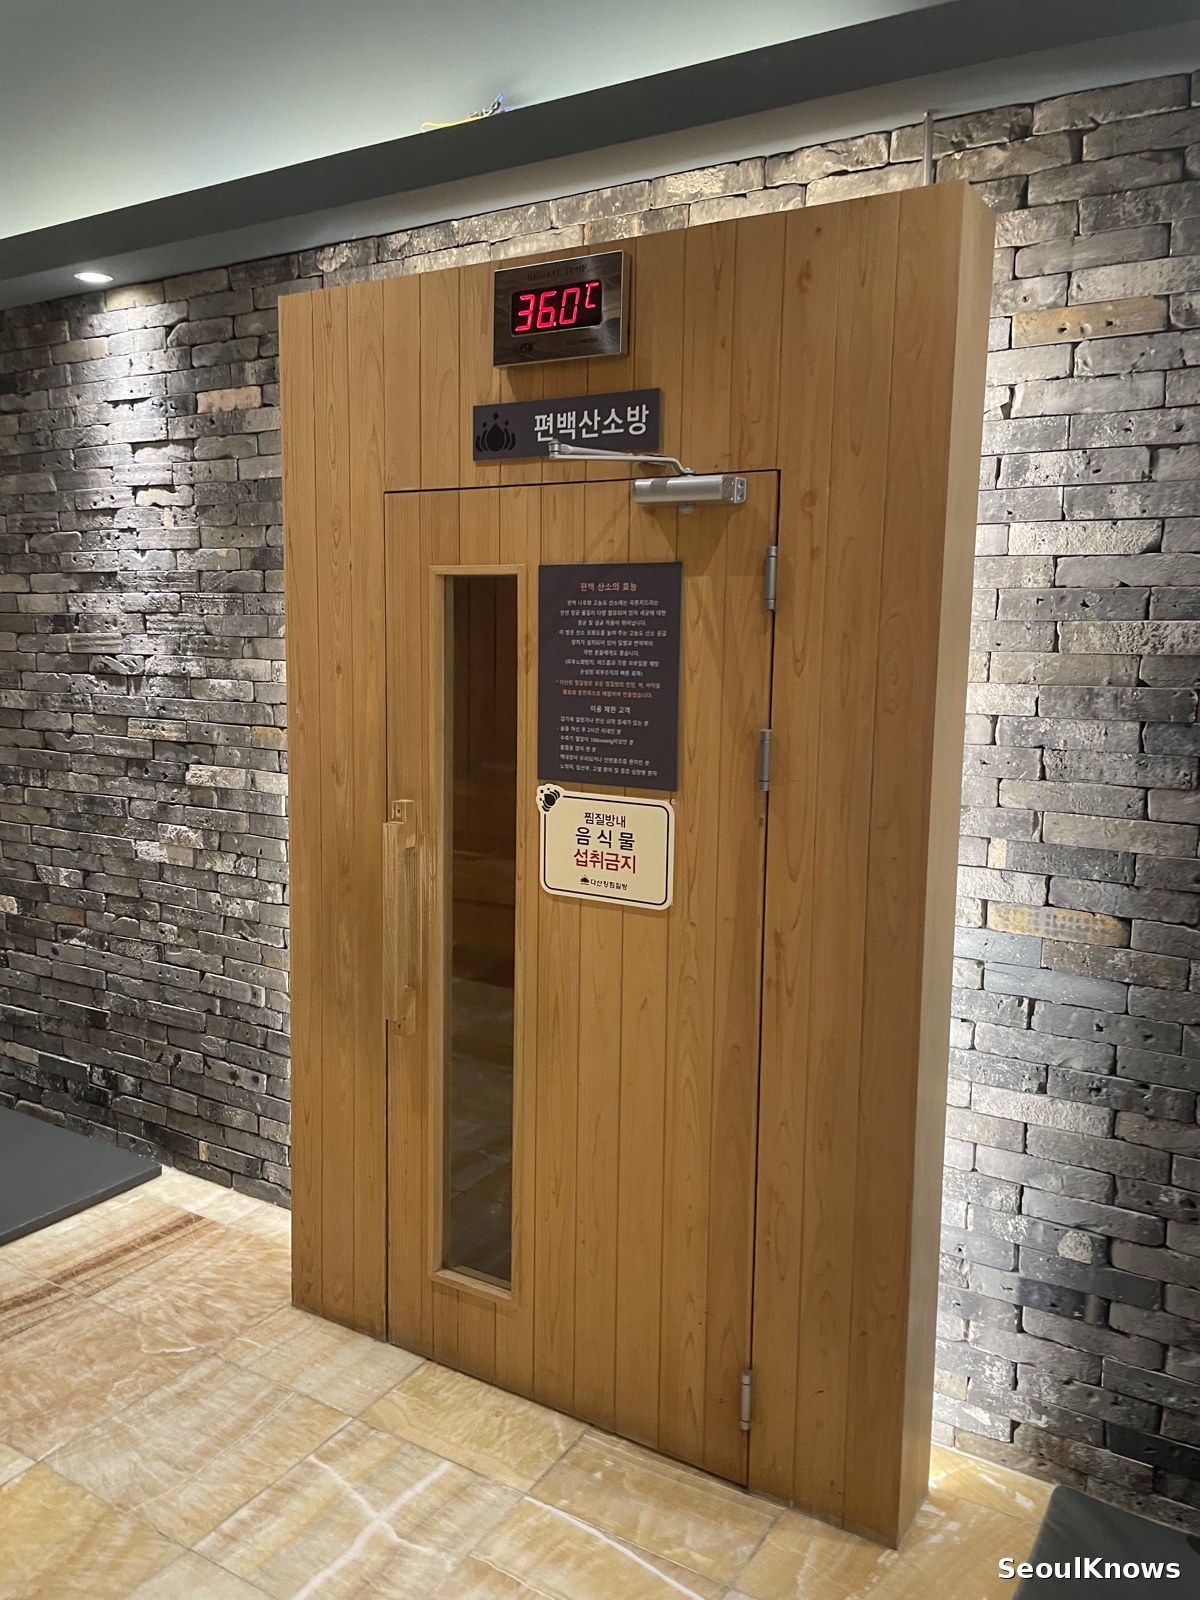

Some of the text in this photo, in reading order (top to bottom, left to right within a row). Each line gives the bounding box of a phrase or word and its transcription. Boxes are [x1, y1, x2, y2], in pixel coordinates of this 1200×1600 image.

[534, 404, 649, 442] 편백산소방
[580, 582, 637, 591] 편백 산소의 효능
[584, 812, 626, 828] 찜질방내
[574, 849, 636, 874] 섭취금지
